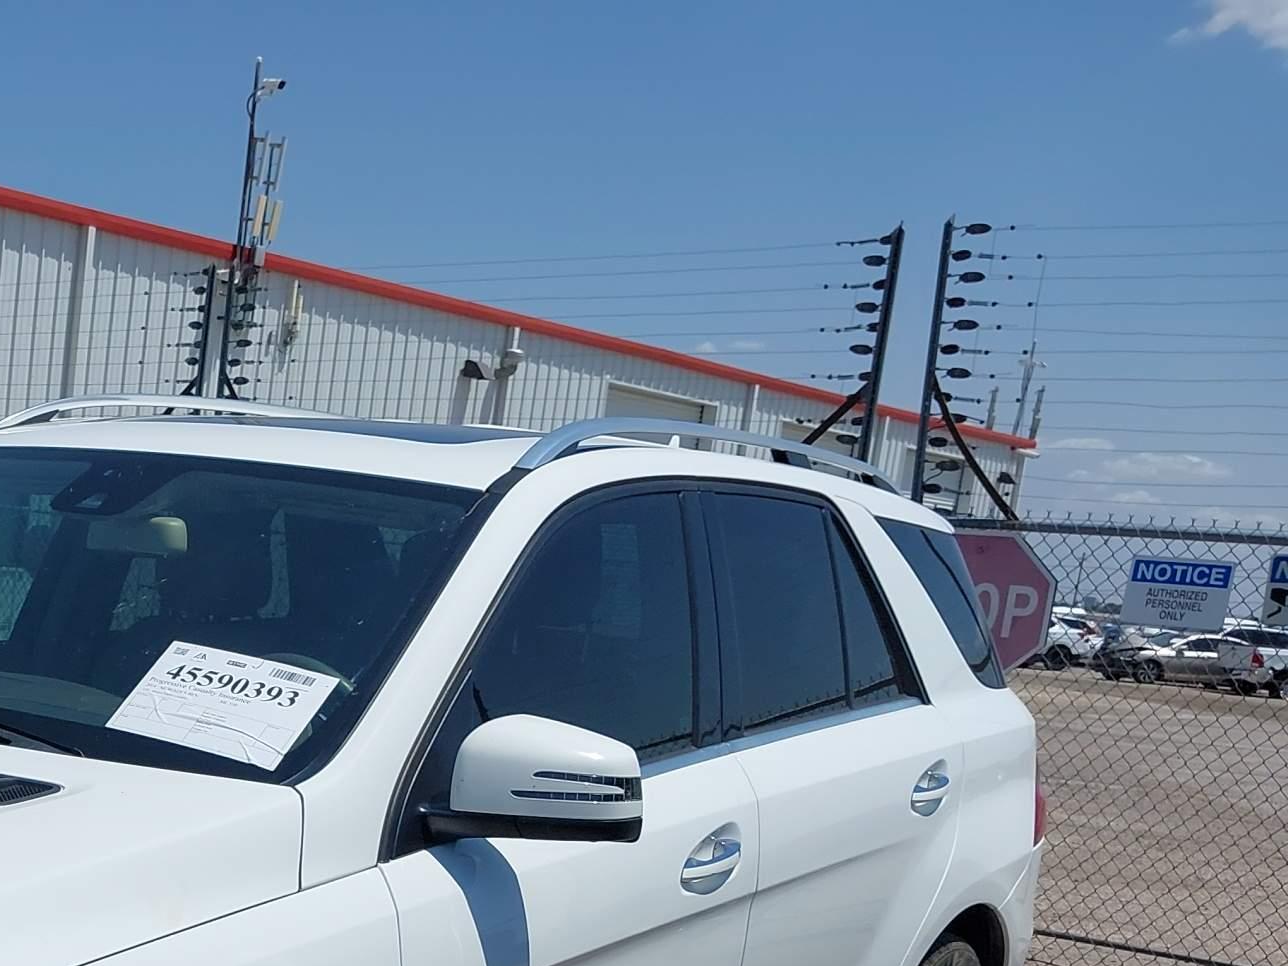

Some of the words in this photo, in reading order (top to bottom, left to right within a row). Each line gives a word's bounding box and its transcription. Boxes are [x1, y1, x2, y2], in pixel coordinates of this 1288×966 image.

[1136, 562, 1227, 585] NOTICE
[1146, 587, 1208, 602] AUTHORIZED
[1145, 598, 1203, 613] PERSONNEL
[1159, 612, 1186, 622] ONLY
[166, 664, 300, 708] 45590393
